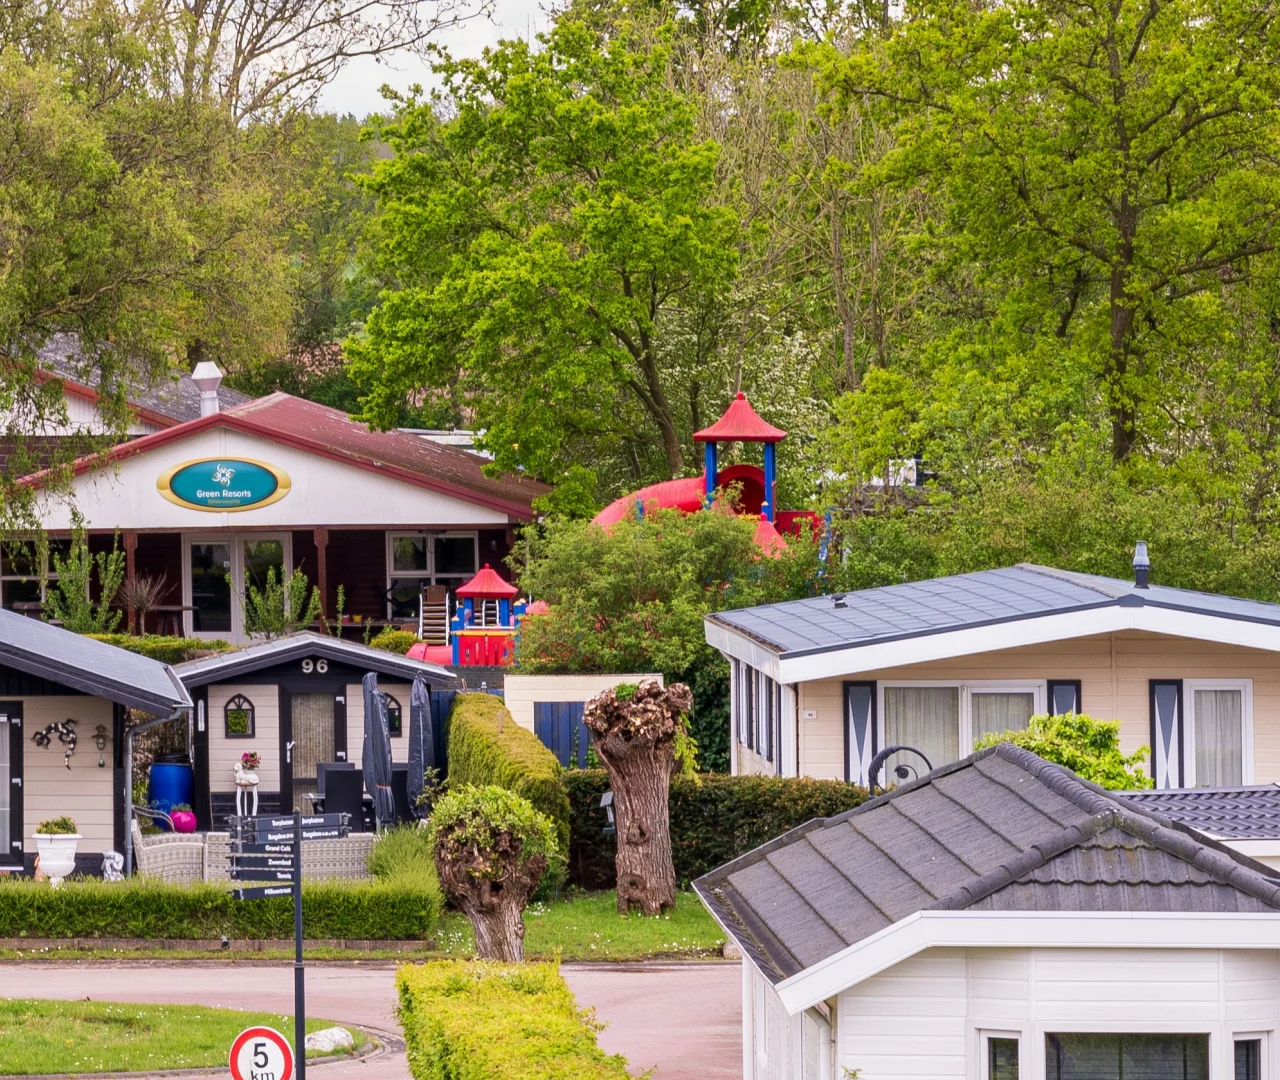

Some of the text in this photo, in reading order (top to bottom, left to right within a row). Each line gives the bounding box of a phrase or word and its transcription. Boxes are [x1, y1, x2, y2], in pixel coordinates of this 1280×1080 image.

[196, 489, 252, 498] Green Resorts
[302, 659, 328, 673] 96
[254, 1043, 269, 1068] 5
